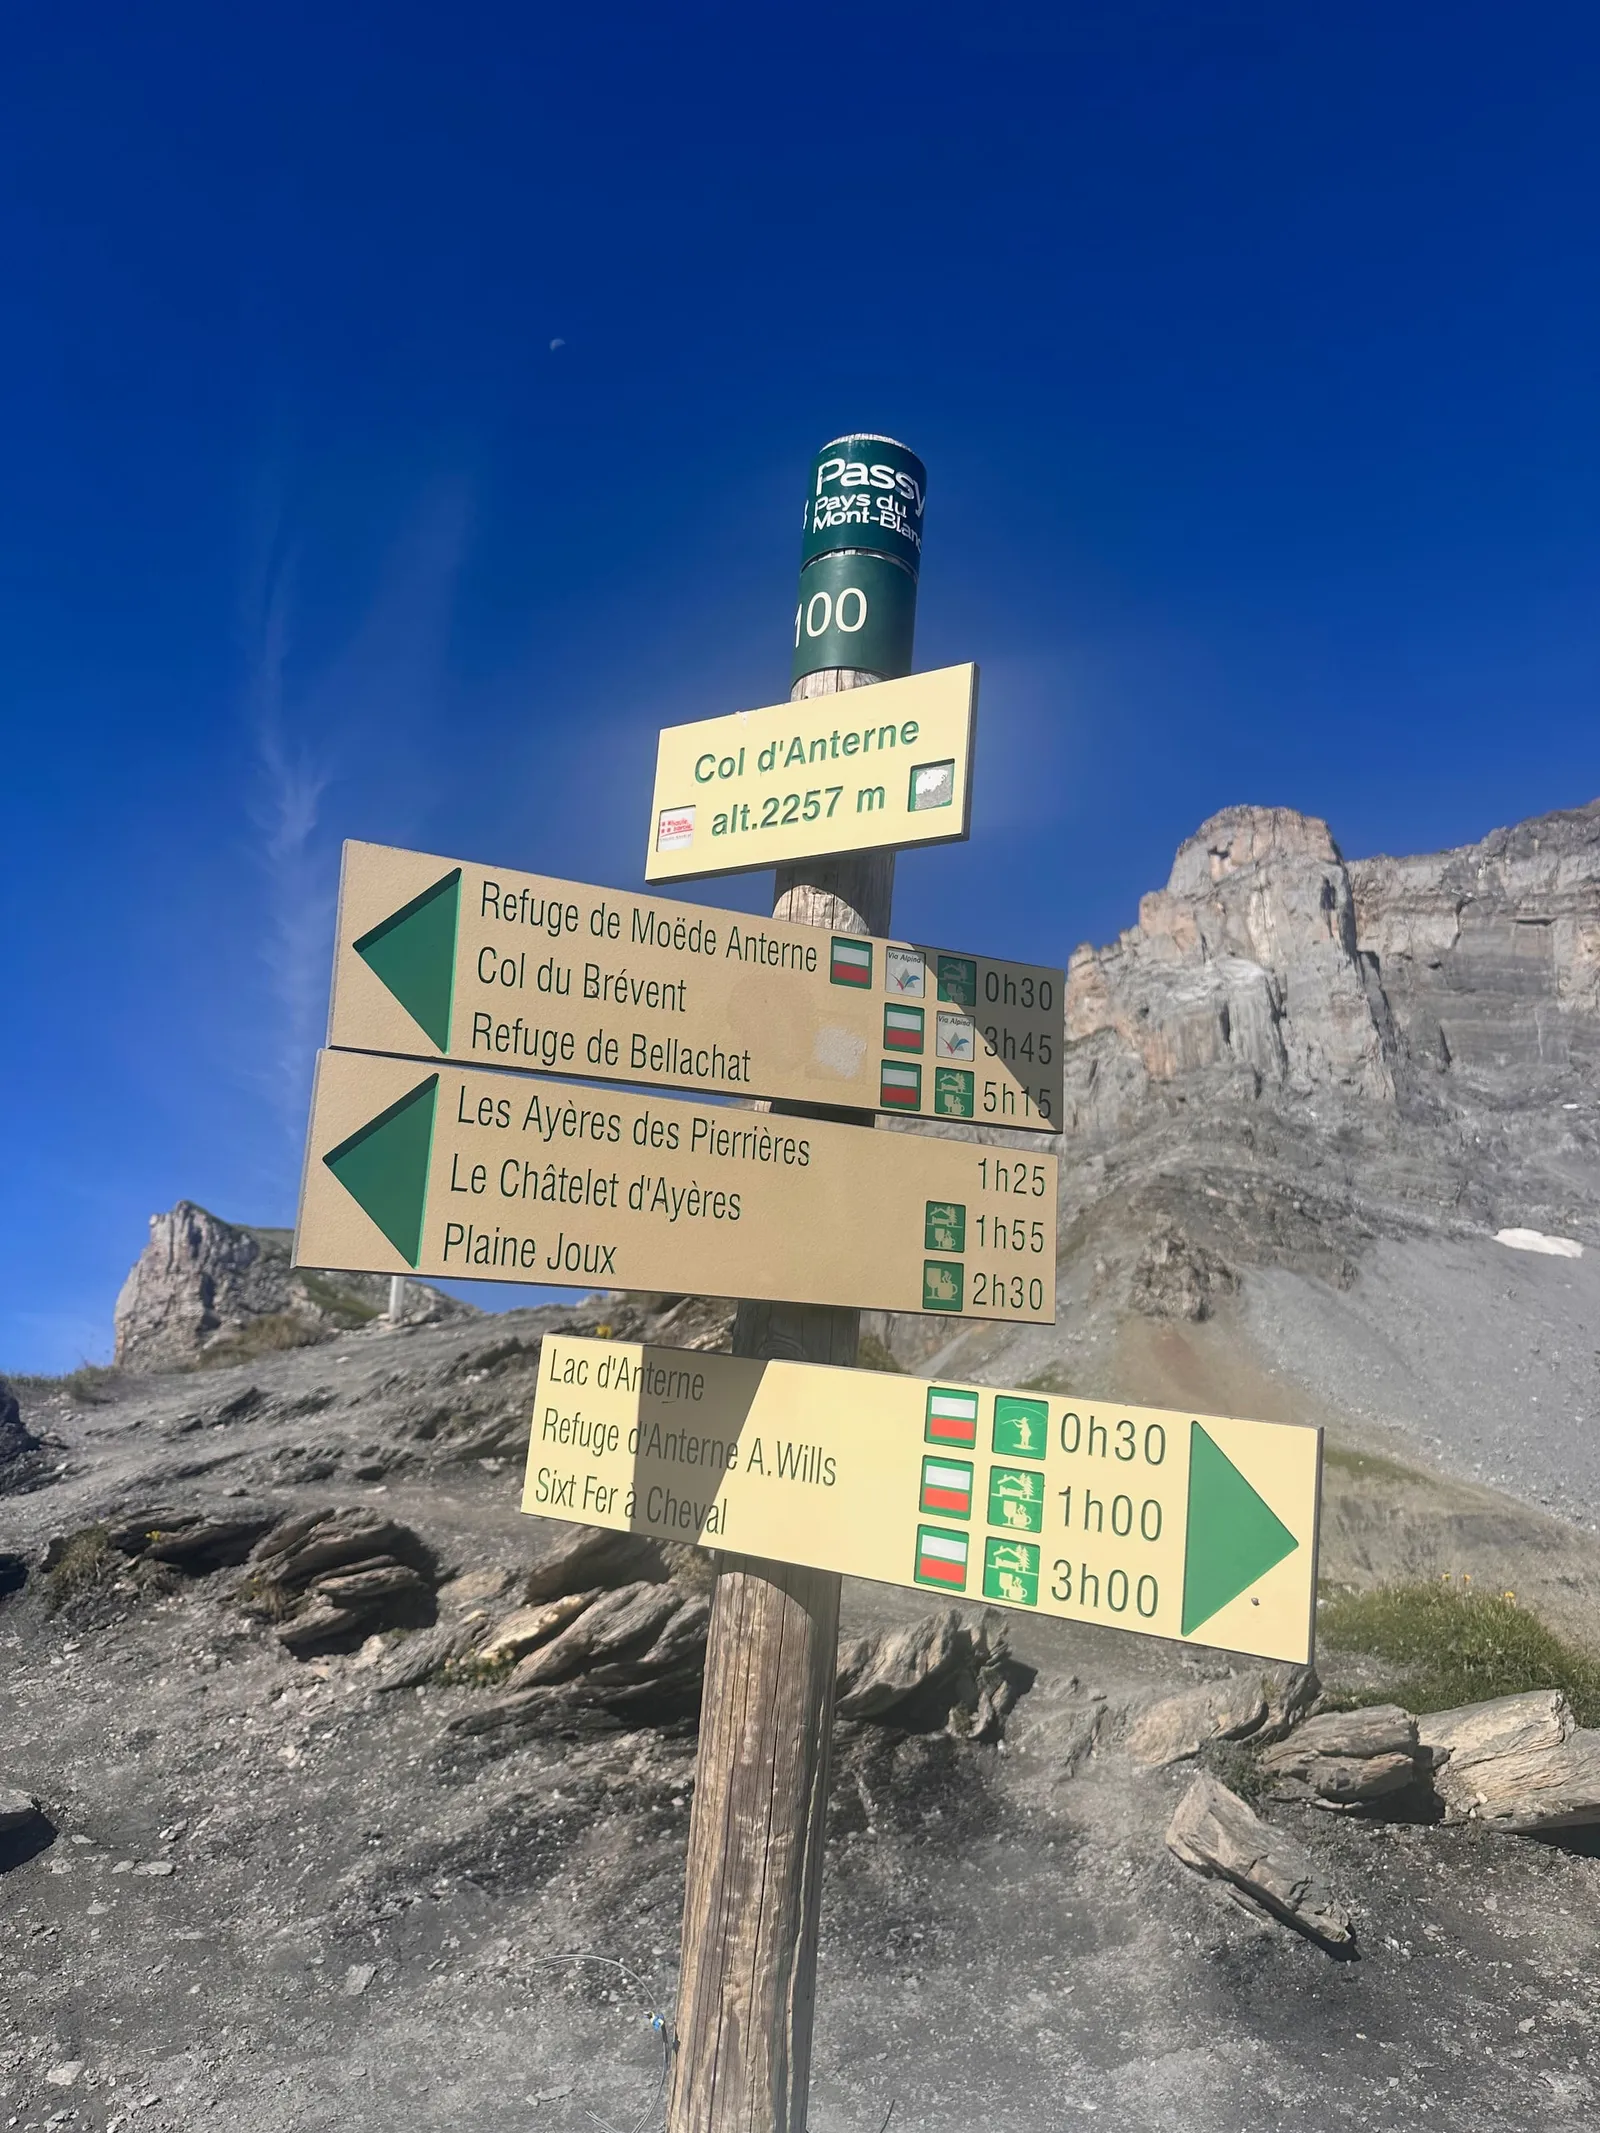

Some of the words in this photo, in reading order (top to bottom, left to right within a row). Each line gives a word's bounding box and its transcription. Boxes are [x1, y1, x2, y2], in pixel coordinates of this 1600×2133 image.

[814, 493, 871, 517] Pays
[876, 494, 907, 518] du
[816, 458, 925, 518] Passy
[694, 747, 746, 784] Col
[757, 720, 919, 773] d'Anterne
[711, 785, 844, 836] alt.2257
[856, 785, 885, 813] m
[481, 881, 579, 937] Refuge
[590, 902, 621, 939] de
[631, 907, 717, 956] Moëde
[726, 926, 818, 972] Anterne
[477, 946, 526, 989] Col
[537, 957, 571, 996] du
[583, 962, 687, 1012] Brévent
[888, 952, 899, 960] Via
[900, 954, 922, 964] Alpina
[985, 971, 1053, 1011] 0h30
[472, 1012, 575, 1066] Refuge
[587, 1029, 619, 1066] de
[631, 1033, 751, 1082] Bellachat
[938, 1015, 948, 1024] Via
[949, 1018, 971, 1027] Alpina
[984, 1026, 1053, 1065] 3h45
[457, 1085, 511, 1129] Les
[522, 1095, 621, 1142] Ayères
[633, 1110, 680, 1150] des
[690, 1117, 810, 1167] Pierrières
[983, 1081, 1051, 1119] 5h15
[450, 1153, 487, 1195] Le
[500, 1158, 620, 1208] Châtelet
[628, 1174, 741, 1222] d'Ayères
[978, 1158, 1045, 1197] 1h25
[443, 1222, 536, 1269] Plaine
[547, 1232, 617, 1275] Joux
[976, 1214, 1044, 1253] 1h55
[972, 1272, 1043, 1311] 2h30
[550, 1348, 589, 1387] Lac
[597, 1355, 705, 1401] d'Anterne
[542, 1407, 619, 1457] Refuge
[628, 1420, 738, 1470] d'Anterne
[746, 1437, 837, 1487] A.Wills
[1060, 1412, 1166, 1466] 0h30
[535, 1467, 577, 1508] Sixt
[582, 1475, 619, 1514] Fer
[624, 1482, 637, 1519] à
[647, 1485, 728, 1535] Cheval
[1058, 1485, 1162, 1541] 1h00
[1051, 1559, 1159, 1618] 3h00
